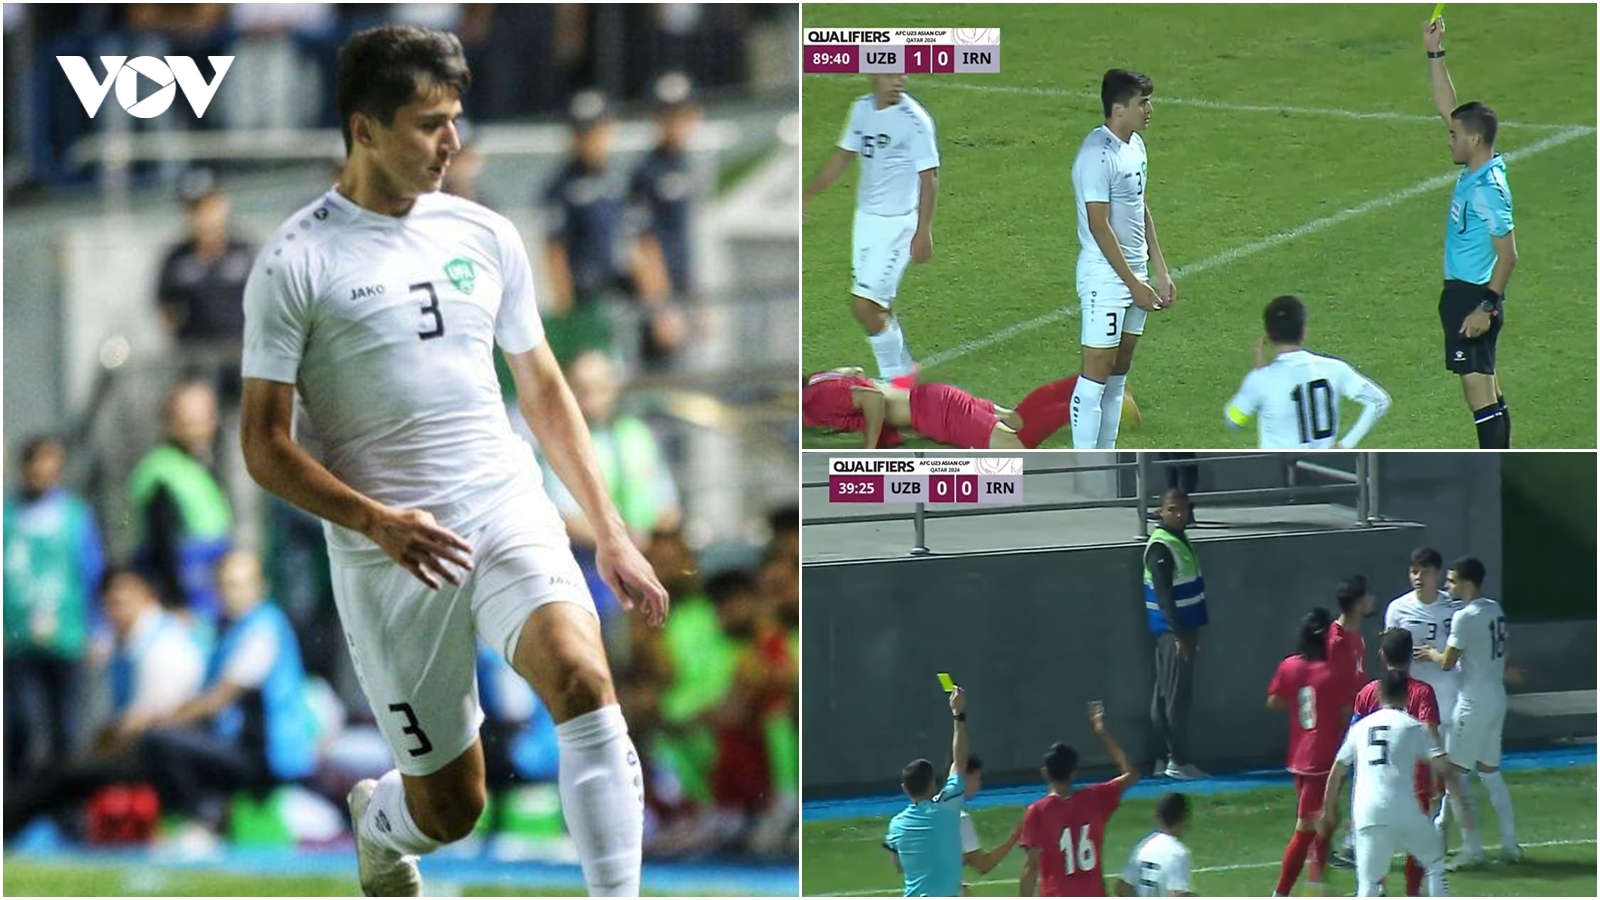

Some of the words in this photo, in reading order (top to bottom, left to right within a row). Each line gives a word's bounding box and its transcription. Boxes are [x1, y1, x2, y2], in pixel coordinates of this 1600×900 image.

[1135, 172, 1143, 196] 3
[350, 284, 386, 301] JAKO
[408, 282, 444, 340] 3
[1106, 312, 1117, 336] 3
[1290, 378, 1337, 444] 10
[1426, 623, 1437, 640] 3
[1297, 686, 1317, 730] 8
[388, 702, 433, 757] 3
[1368, 726, 1390, 766] 5
[1059, 824, 1097, 876] 16
